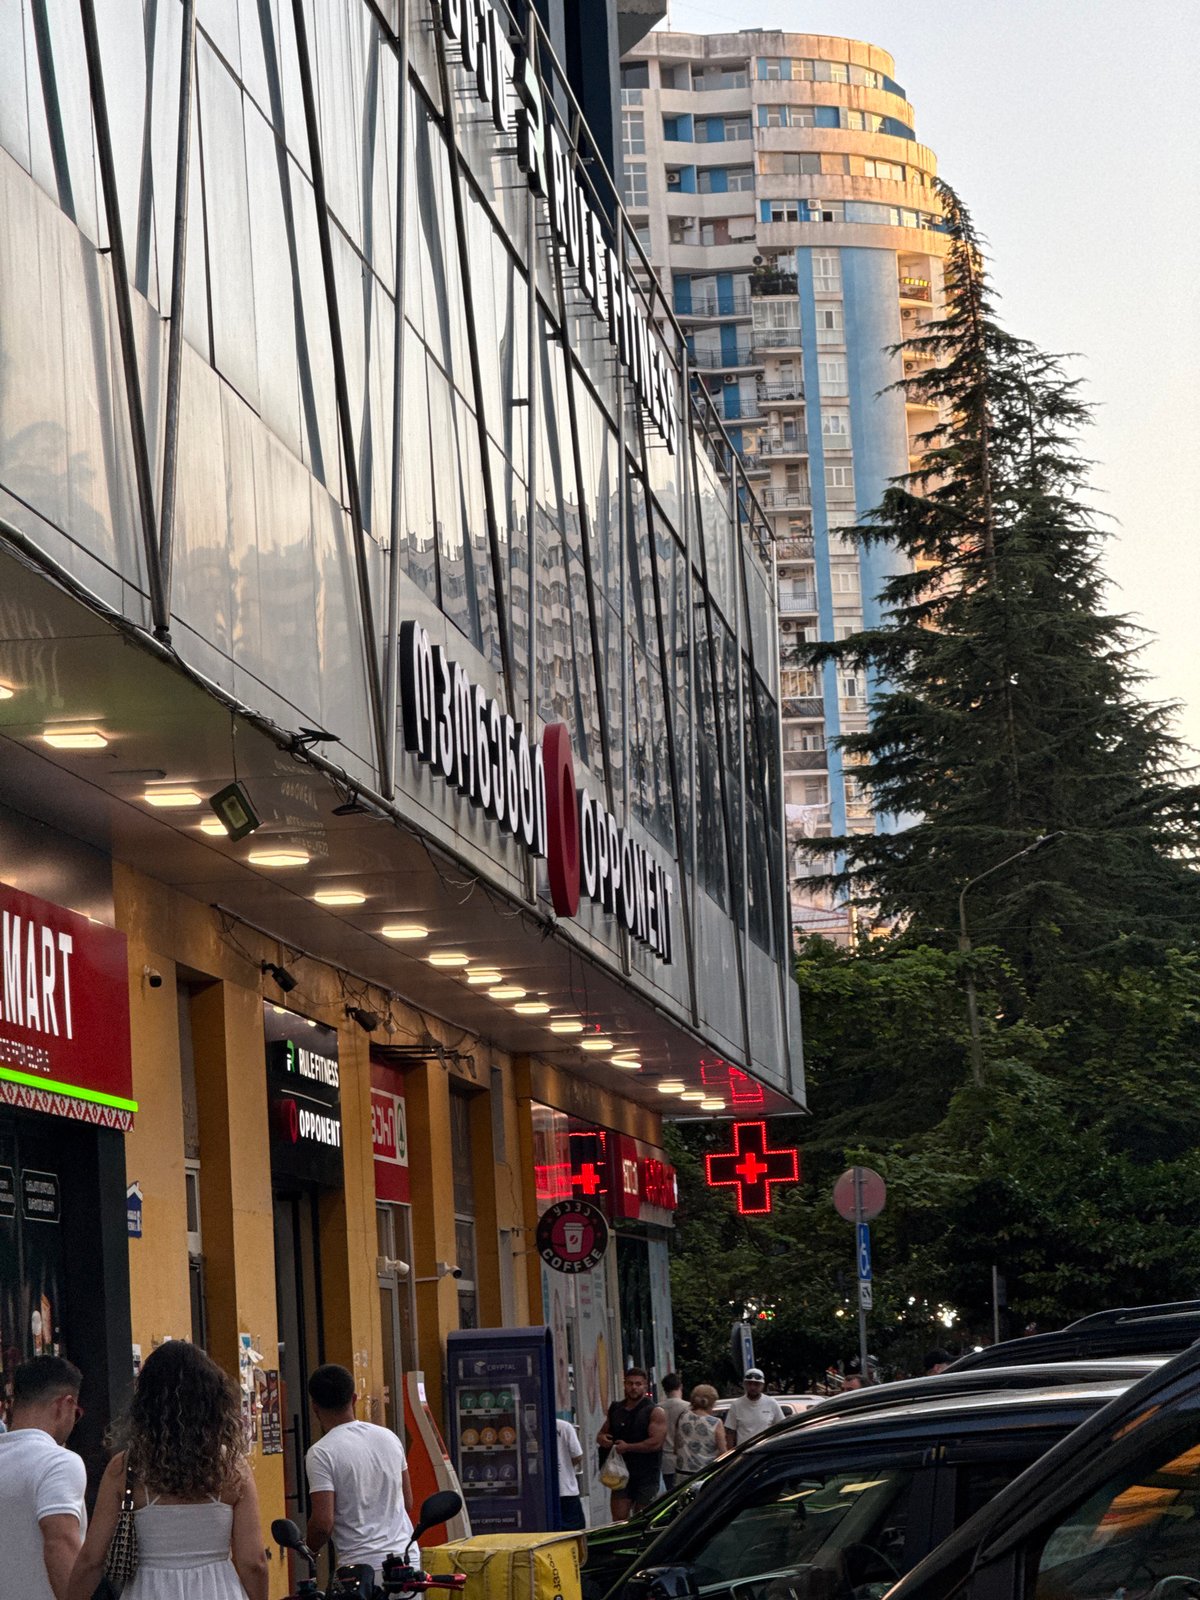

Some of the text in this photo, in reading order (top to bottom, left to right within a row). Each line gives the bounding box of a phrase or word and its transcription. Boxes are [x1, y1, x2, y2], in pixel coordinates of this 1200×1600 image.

[549, 122, 608, 322] RULE
[606, 247, 678, 456] FITNESS
[578, 788, 673, 964] OPPONENT
[299, 1109, 341, 1147] OPPONENT
[541, 1247, 603, 1273] COFFEE
